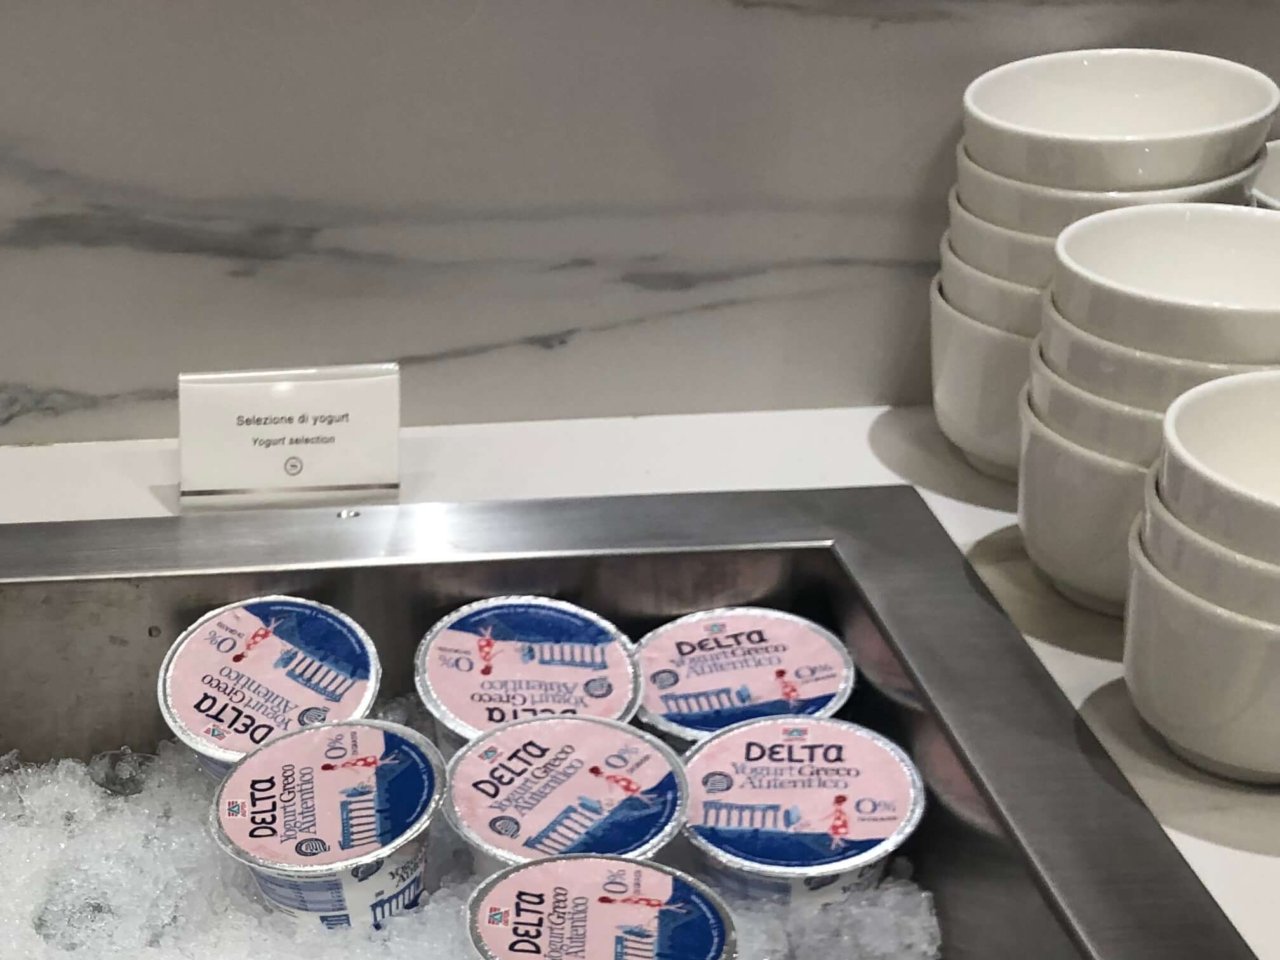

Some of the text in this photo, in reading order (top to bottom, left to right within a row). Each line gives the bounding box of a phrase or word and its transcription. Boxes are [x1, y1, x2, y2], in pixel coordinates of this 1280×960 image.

[236, 413, 349, 426] Selezione di yogurt
[252, 435, 335, 448] Yogurt selection
[203, 629, 237, 655] 0%
[675, 629, 768, 657] DELTA
[219, 665, 301, 714] Autentico
[193, 691, 275, 745] DELTA
[325, 733, 348, 760] 0%
[604, 744, 639, 770] 0%
[744, 741, 846, 763] DELTA
[472, 740, 551, 799] DELTA
[738, 775, 849, 791] Autentico
[298, 766, 318, 835] Autentico
[513, 757, 585, 818] Autentico
[248, 775, 278, 838] DELTA
[854, 797, 898, 816] 0%
[602, 867, 630, 895] 0%
[508, 890, 545, 956] DELTA
[564, 896, 589, 960] Autentico
